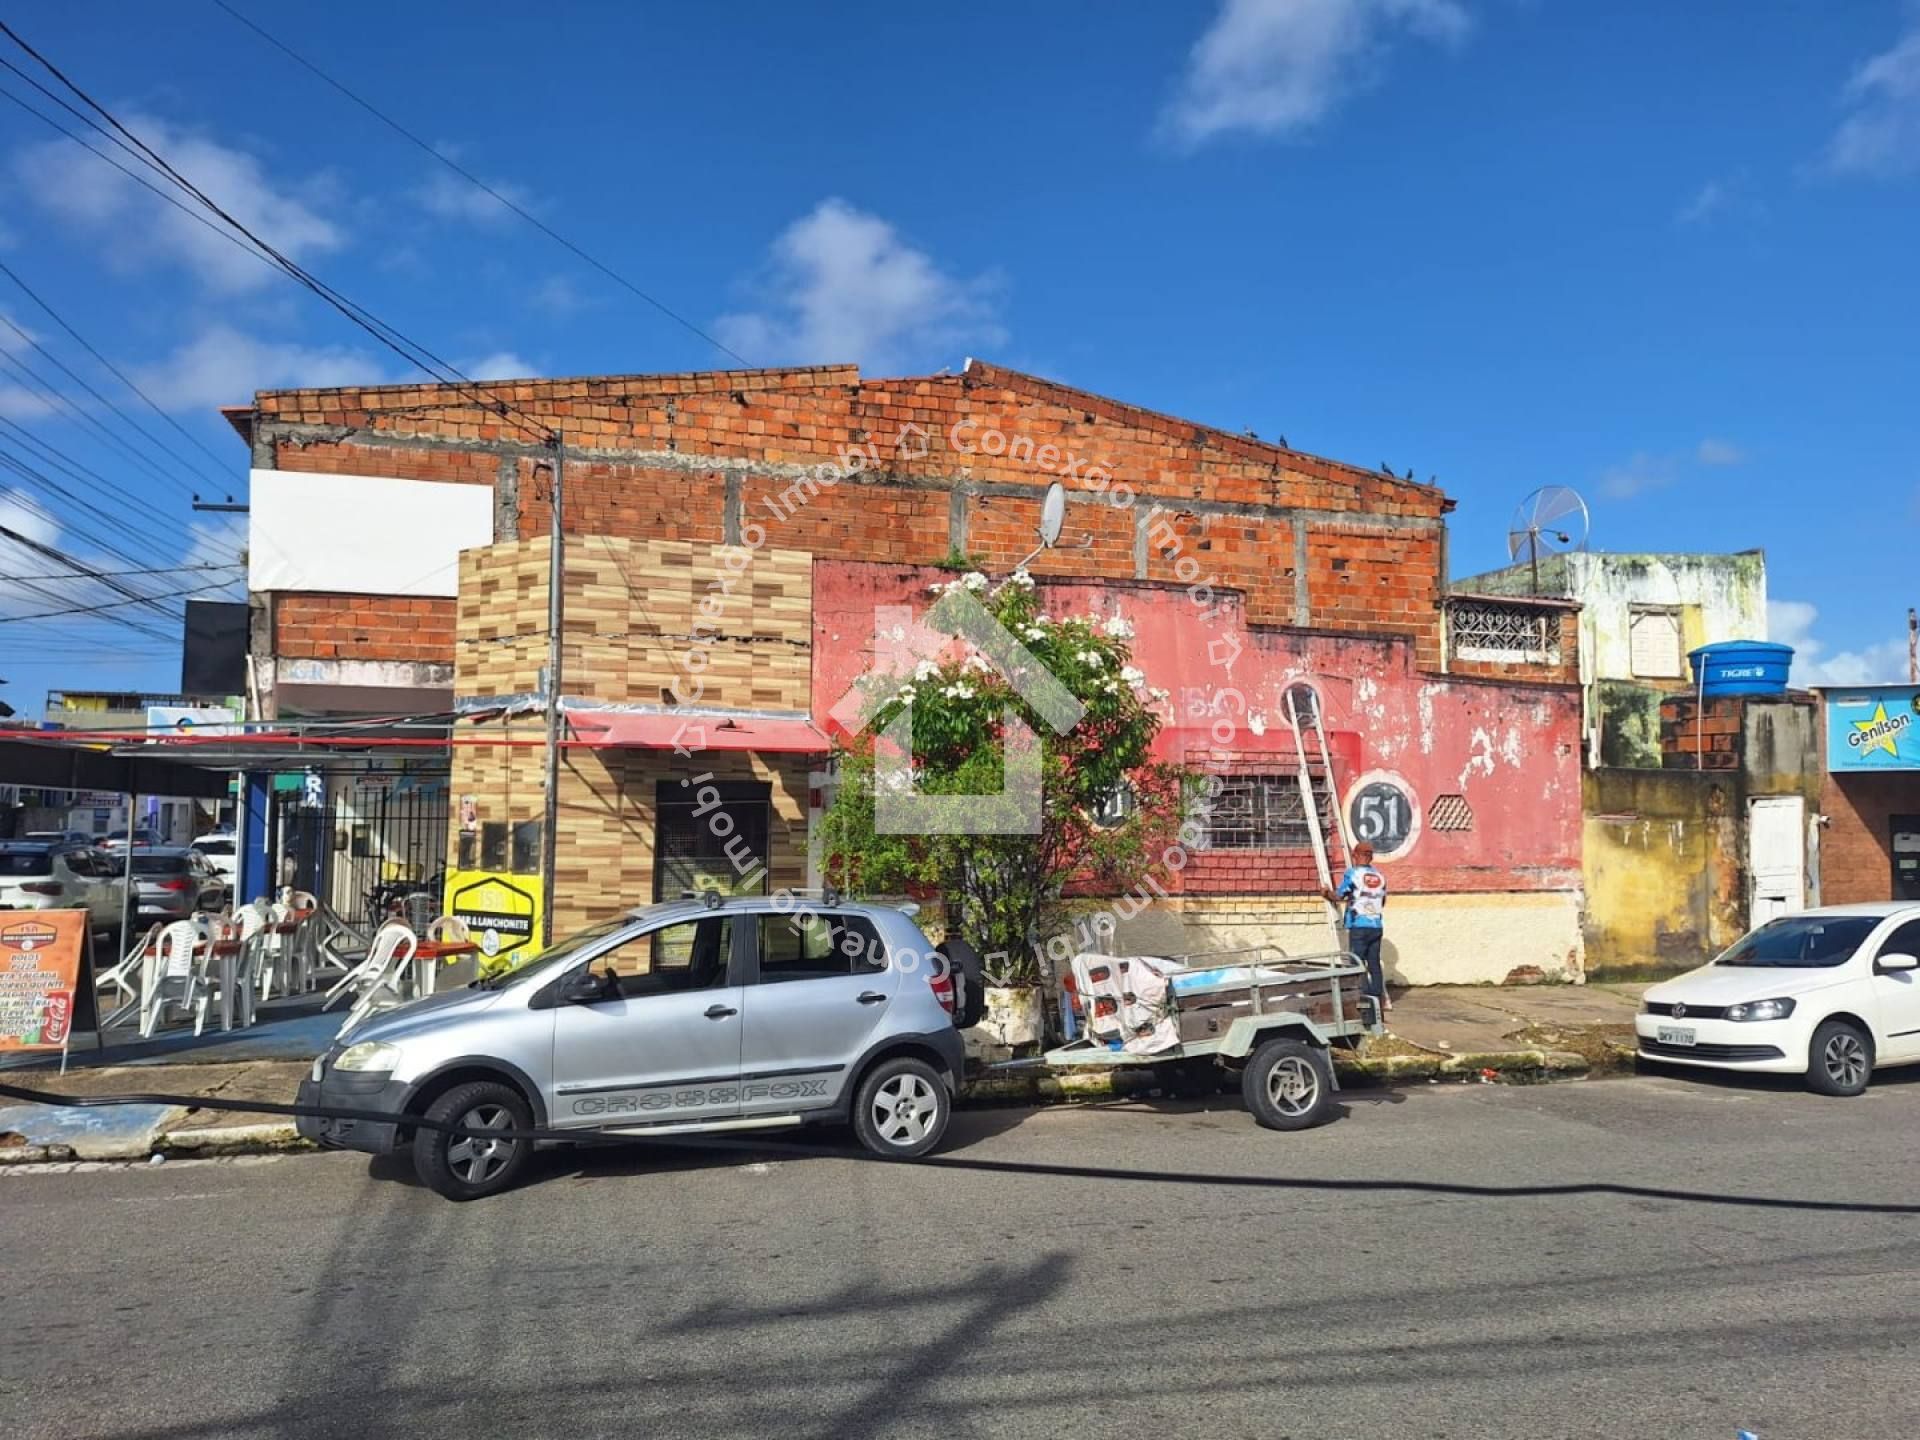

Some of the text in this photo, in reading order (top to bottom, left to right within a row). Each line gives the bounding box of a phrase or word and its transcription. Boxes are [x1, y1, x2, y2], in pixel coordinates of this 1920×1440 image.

[1720, 669, 1750, 678] TIGRE
[1848, 714, 1910, 747] Genilson
[1359, 795, 1399, 839] 51
[572, 1079, 827, 1116] CROSSFOX
